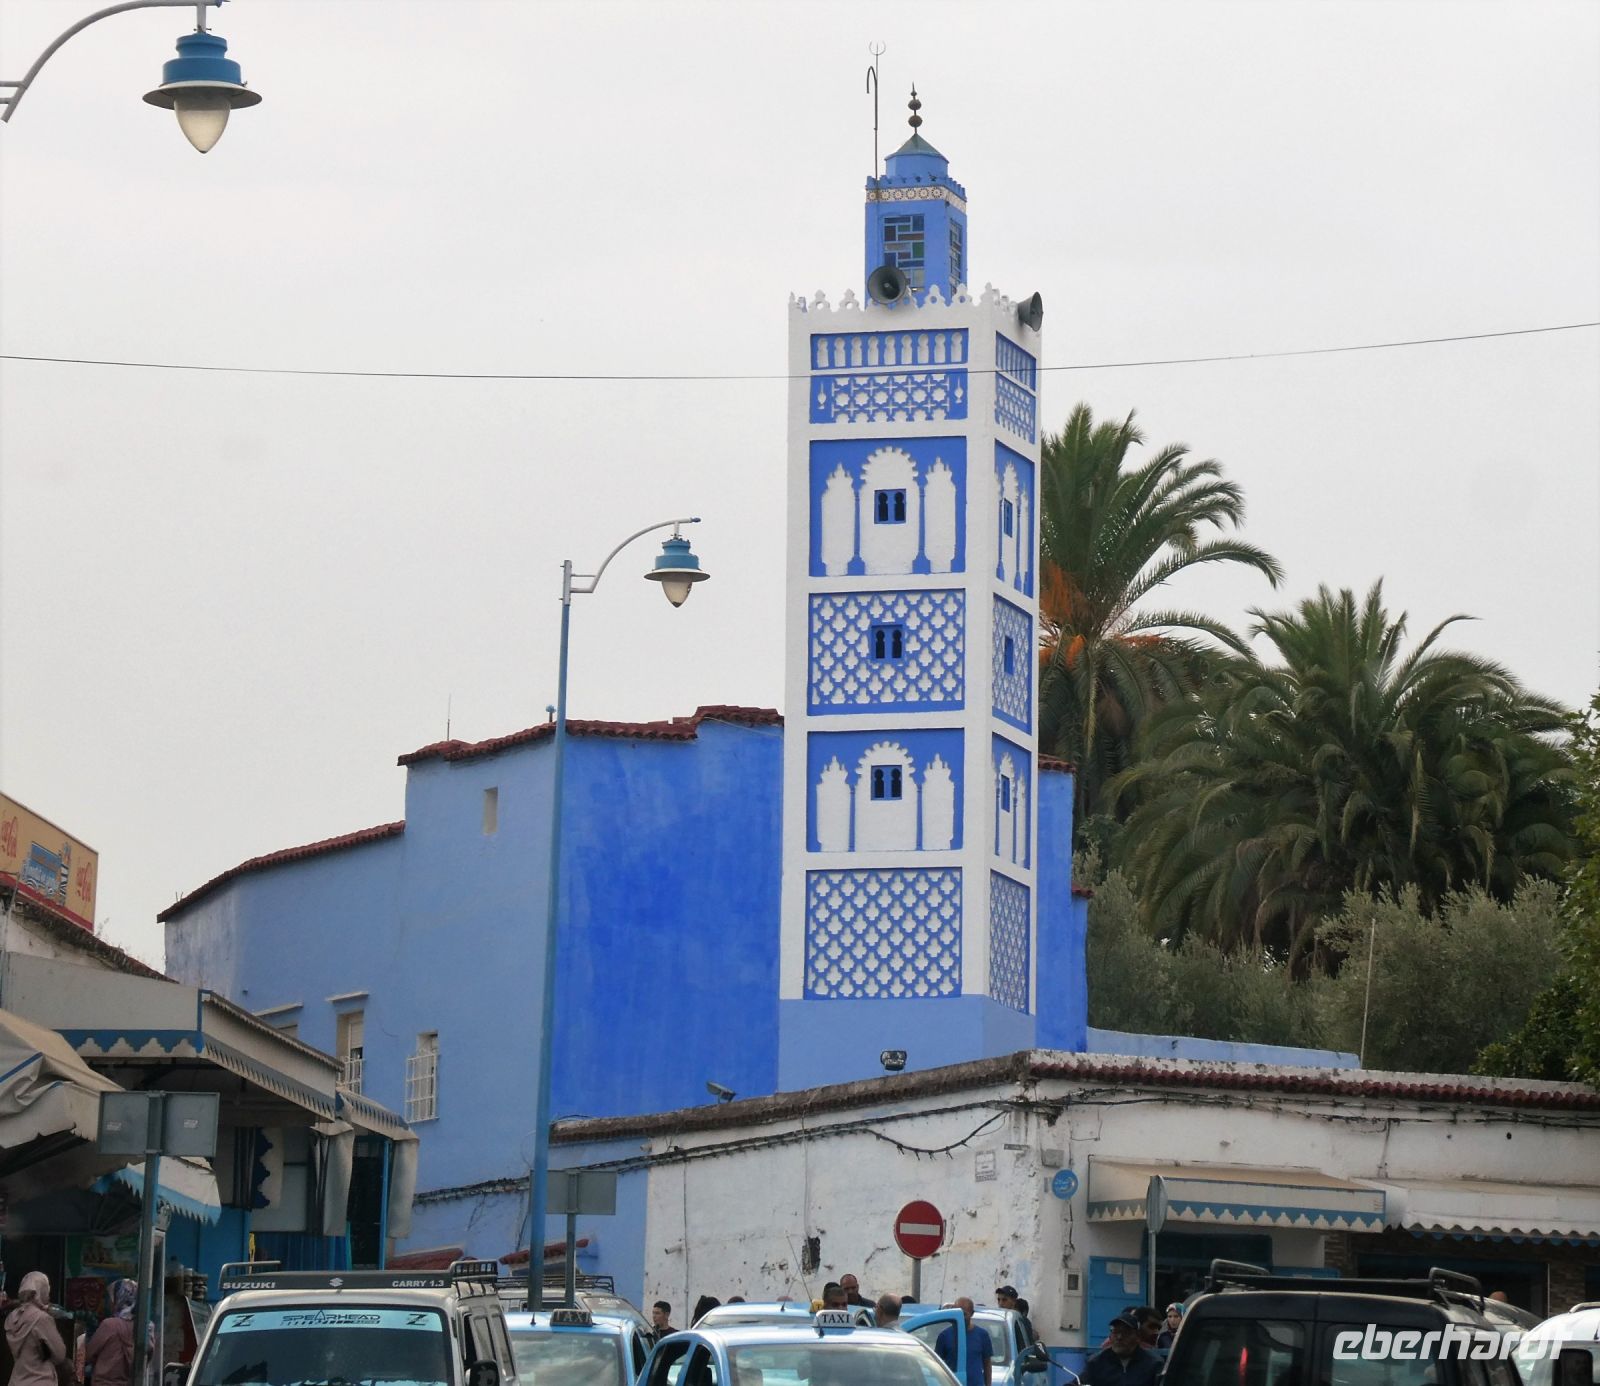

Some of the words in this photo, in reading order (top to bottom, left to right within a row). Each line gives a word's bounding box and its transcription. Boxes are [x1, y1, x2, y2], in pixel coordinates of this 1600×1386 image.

[222, 1281, 276, 1289] SUZUKI
[391, 1280, 426, 1288] CARRY
[429, 1279, 445, 1287] 1.3
[282, 1309, 381, 1322] SPEARHEAD
[554, 1310, 591, 1323] TAXI
[822, 1313, 851, 1324] TAXI
